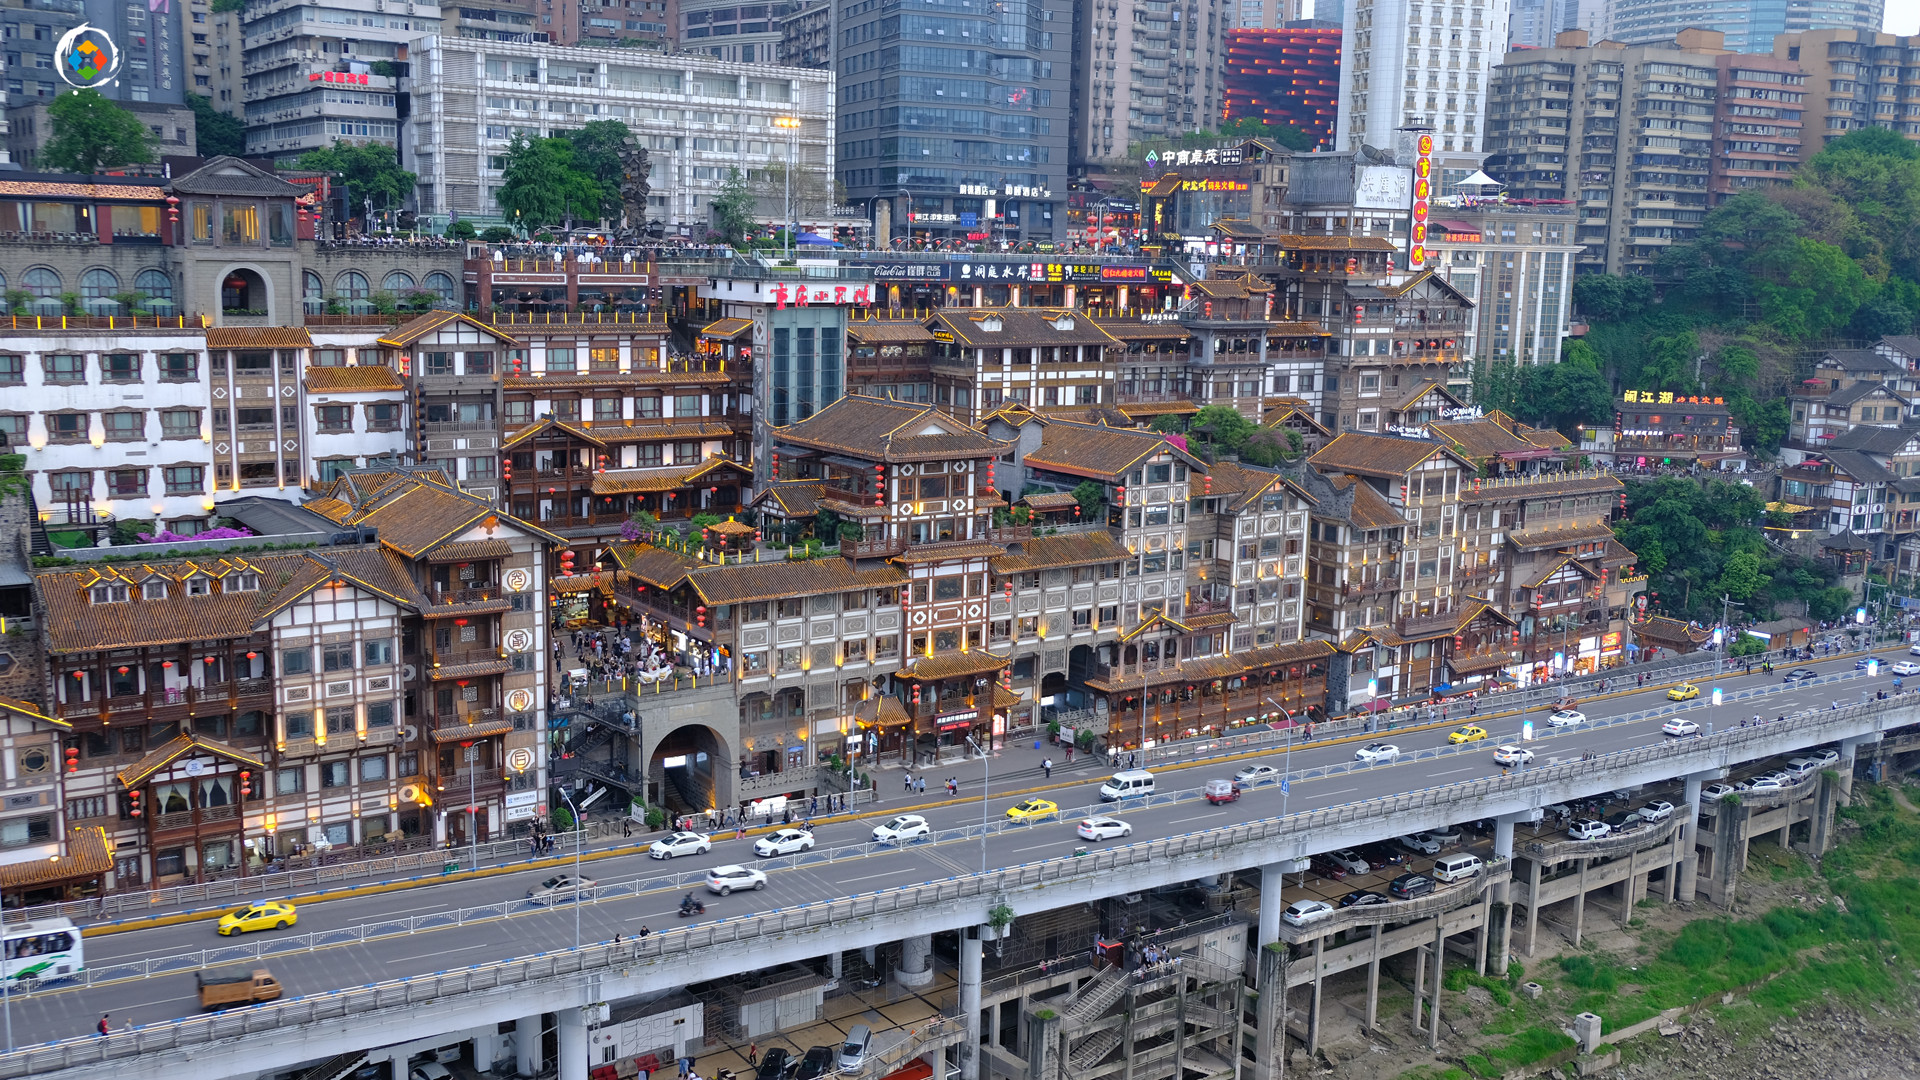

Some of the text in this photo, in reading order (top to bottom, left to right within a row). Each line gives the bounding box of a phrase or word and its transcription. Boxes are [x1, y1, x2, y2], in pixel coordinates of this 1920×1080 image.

[1162, 149, 1219, 166] 中商卓茂
[1361, 173, 1407, 195] 洪崖洞
[974, 264, 1028, 279] 洞庭水岸
[1624, 389, 1673, 404] 闹江湖
